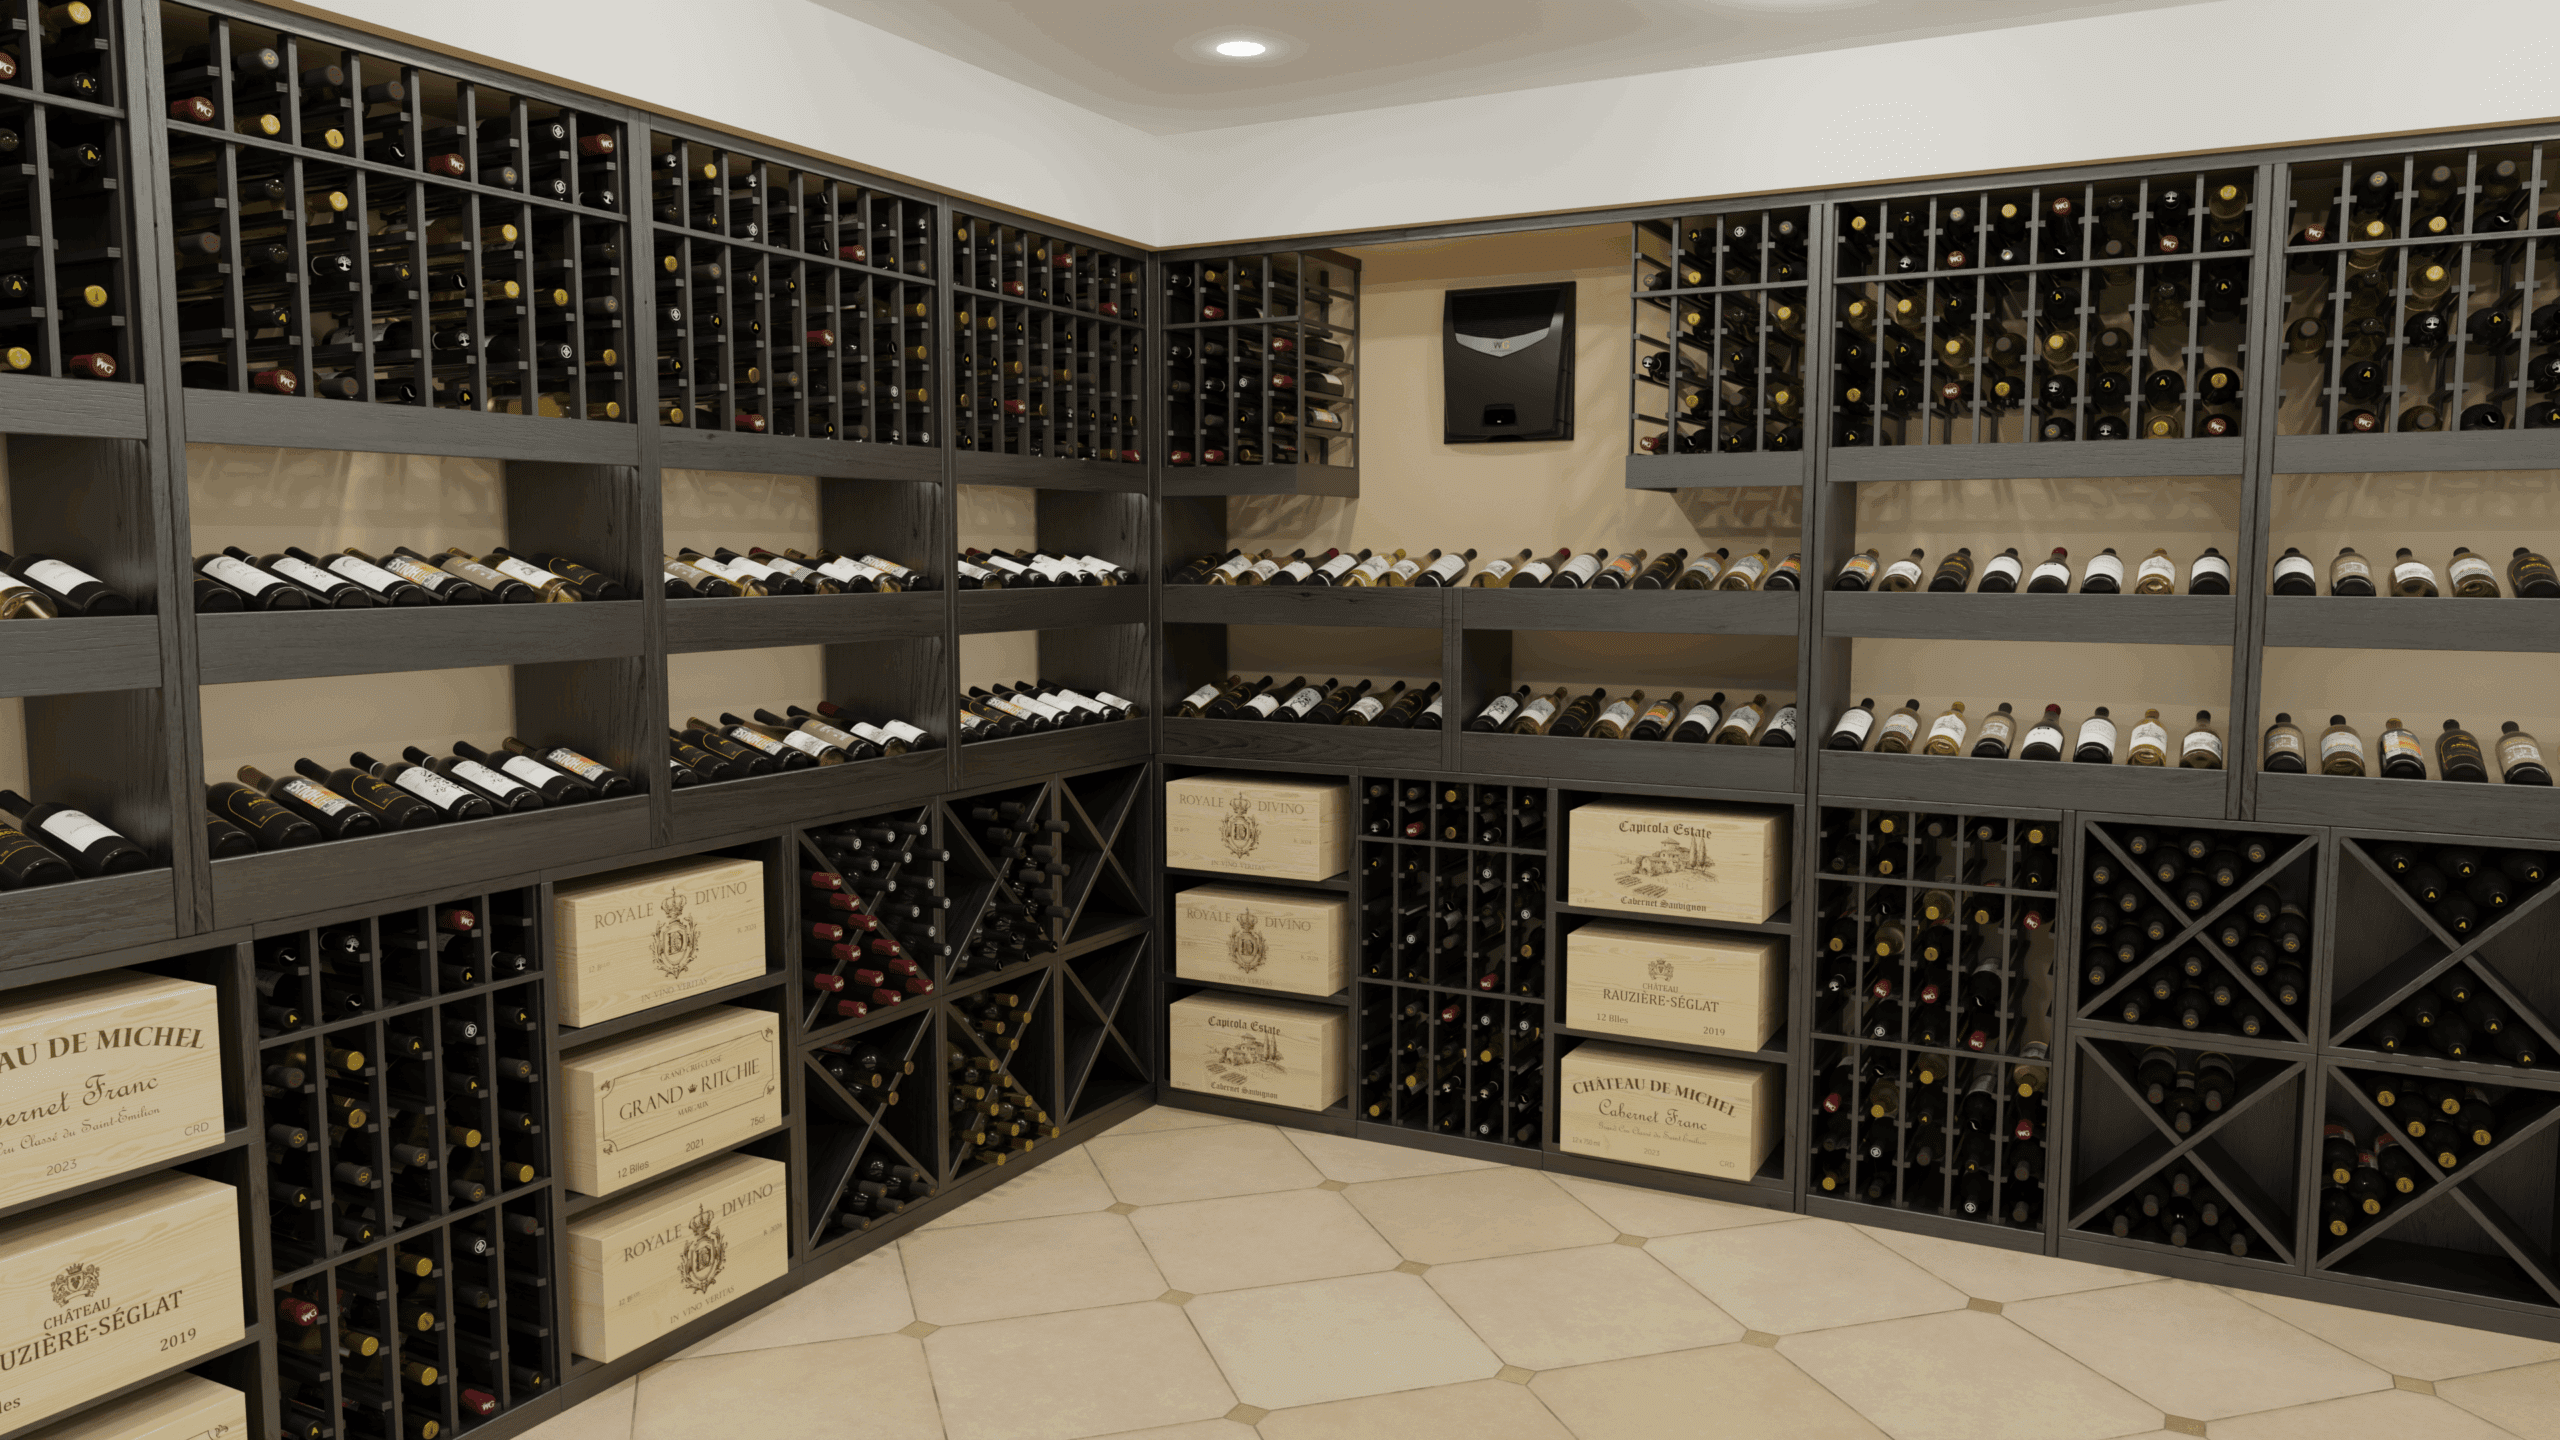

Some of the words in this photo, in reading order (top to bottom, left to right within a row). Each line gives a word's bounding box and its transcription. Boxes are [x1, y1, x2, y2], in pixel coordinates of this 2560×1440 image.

[196, 100, 212, 118] WG
[600, 140, 614, 148] WG
[450, 158, 464, 172] WG
[2054, 202, 2068, 210] WG
[2308, 228, 2322, 238] WG
[2164, 238, 2176, 248] WG
[1950, 254, 1962, 262] WG
[1494, 340, 1510, 350] WG
[96, 358, 114, 374] WG
[280, 374, 294, 388] WG
[2210, 422, 2224, 432] WG
[2358, 418, 2372, 428] WG
[1179, 794, 1224, 808] ROYALE
[1258, 801, 1304, 815] DIVINO
[1619, 820, 1669, 834] Capicola
[1673, 824, 1712, 840] Estate
[594, 902, 655, 930] ROYALE
[694, 881, 748, 906] DIVINO
[1620, 896, 1658, 908] Cabernet
[1660, 900, 1706, 912] Sauvignon
[460, 916, 474, 926] WG
[1187, 908, 1231, 922] ROYALE
[1265, 917, 1311, 932] DIVINO
[2026, 918, 2038, 928] WG
[1642, 982, 1679, 994] CHÂTEAU
[1876, 986, 1886, 996] WG
[1602, 988, 1720, 1013] RAUZIÈRE-SÉGLAT
[1596, 1013, 1606, 1022] 12
[1208, 1015, 1248, 1030] Capicola
[1250, 1020, 1281, 1036] Estate
[1703, 1026, 1726, 1036] 2019
[47, 1032, 88, 1060] DE
[95, 1026, 205, 1050] MICHEL
[82, 1073, 158, 1106] Franc
[619, 1085, 684, 1120] GRAND
[702, 1058, 760, 1092] RITCHIE
[1210, 1082, 1240, 1093] Cabernet
[1241, 1086, 1278, 1100] Sauvignon
[1572, 1076, 1646, 1094] CHÂTEAU
[1650, 1080, 1670, 1094] DE
[1675, 1085, 1737, 1118] MICHEL
[1599, 1098, 1660, 1124] Cabernet
[1664, 1108, 1708, 1130] Franc
[1826, 1102, 1836, 1112] WG
[750, 1114, 766, 1126] 75cl
[20, 1133, 58, 1150] Classé
[63, 1128, 76, 1140] du
[81, 1105, 160, 1134] Saint-Émilion
[184, 1122, 210, 1136] CRD
[686, 1138, 704, 1152] 2021
[1643, 1148, 1660, 1156] 2023
[46, 1158, 77, 1176] 2023
[1719, 1160, 1735, 1168] CRD
[617, 1168, 628, 1179] 12
[623, 1224, 682, 1262] ROYALE
[722, 1183, 774, 1217] DIVINO
[669, 1314, 680, 1324] IN
[682, 1302, 702, 1318] VINO
[705, 1285, 735, 1305] VERITAS
[43, 1297, 110, 1330] CHÂTEAU
[302, 1308, 318, 1322] WG
[0, 1290, 182, 1371] UZIÈRE-SÉGLAT
[160, 1327, 196, 1352] 2019
[482, 1400, 494, 1410] WG
